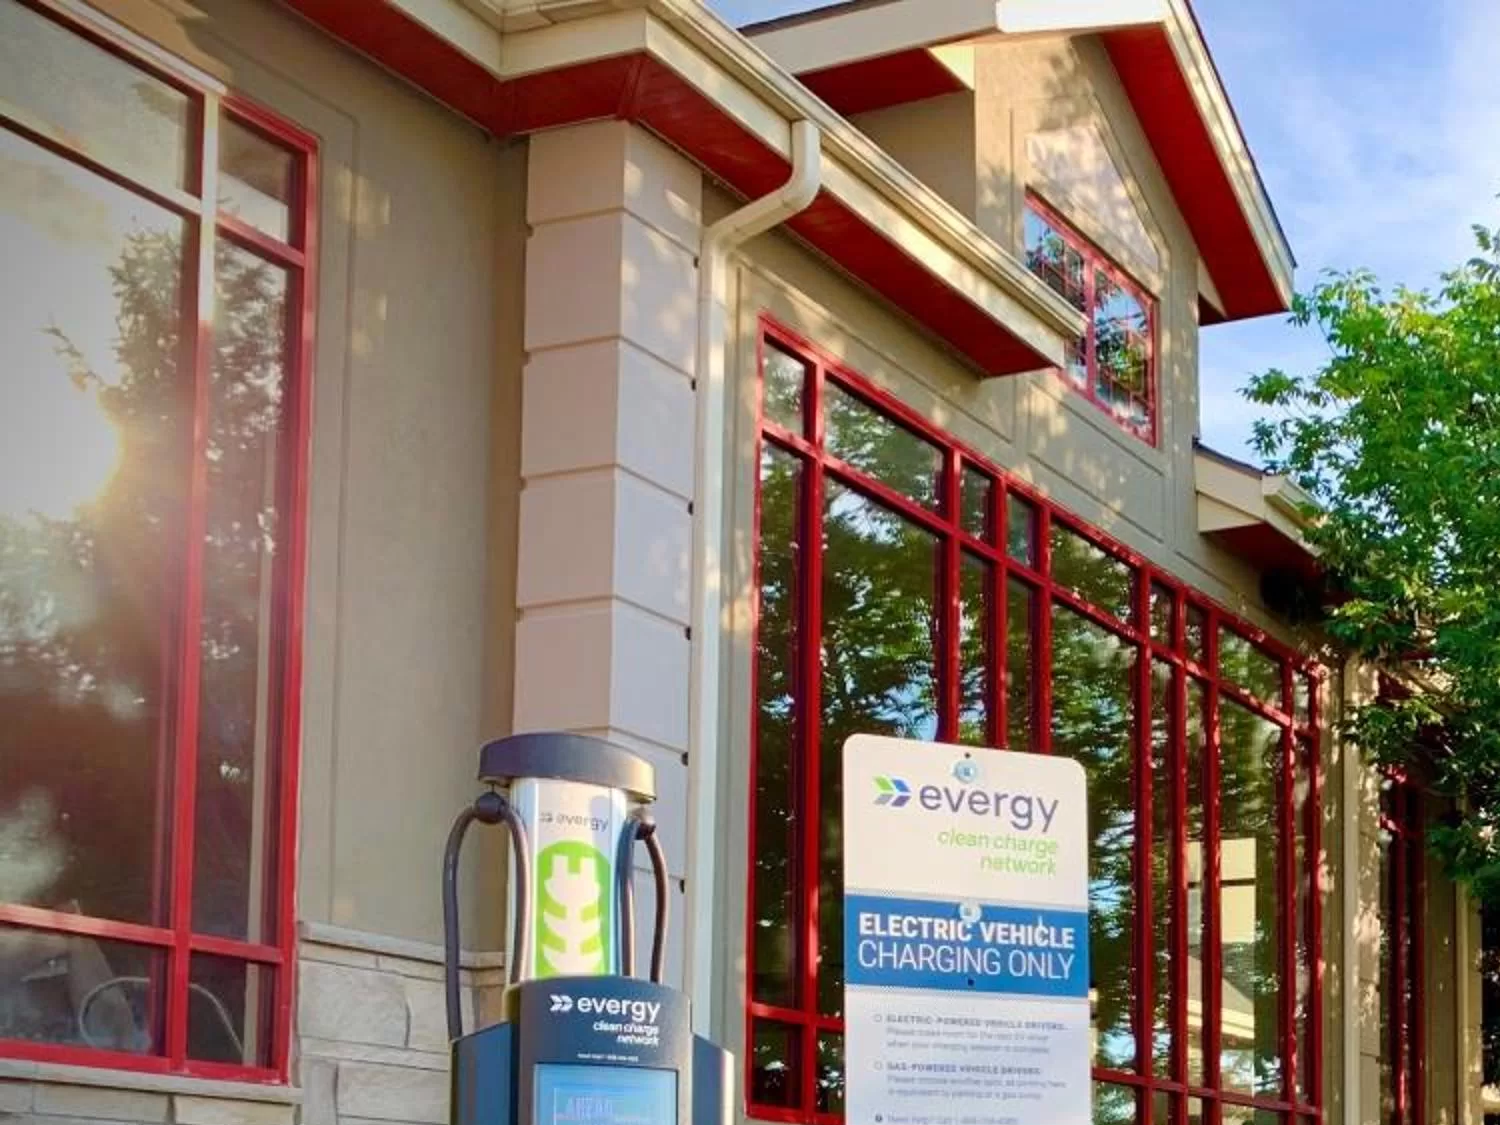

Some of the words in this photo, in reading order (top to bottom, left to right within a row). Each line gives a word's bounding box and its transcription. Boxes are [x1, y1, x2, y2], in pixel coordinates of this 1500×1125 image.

[557, 813, 609, 832] evergy
[919, 785, 1059, 833] evergy
[937, 828, 989, 850] clean
[993, 830, 1059, 858] charge
[980, 853, 1057, 876] network
[859, 912, 973, 943] ELECTRIC
[980, 923, 1076, 950] VEHICLE
[857, 939, 1001, 976] CHARGING
[1008, 949, 1076, 980] ONLY
[577, 996, 661, 1024] evergy
[593, 1021, 622, 1032] clean
[623, 1023, 660, 1037] charge
[617, 1034, 660, 1047] network
